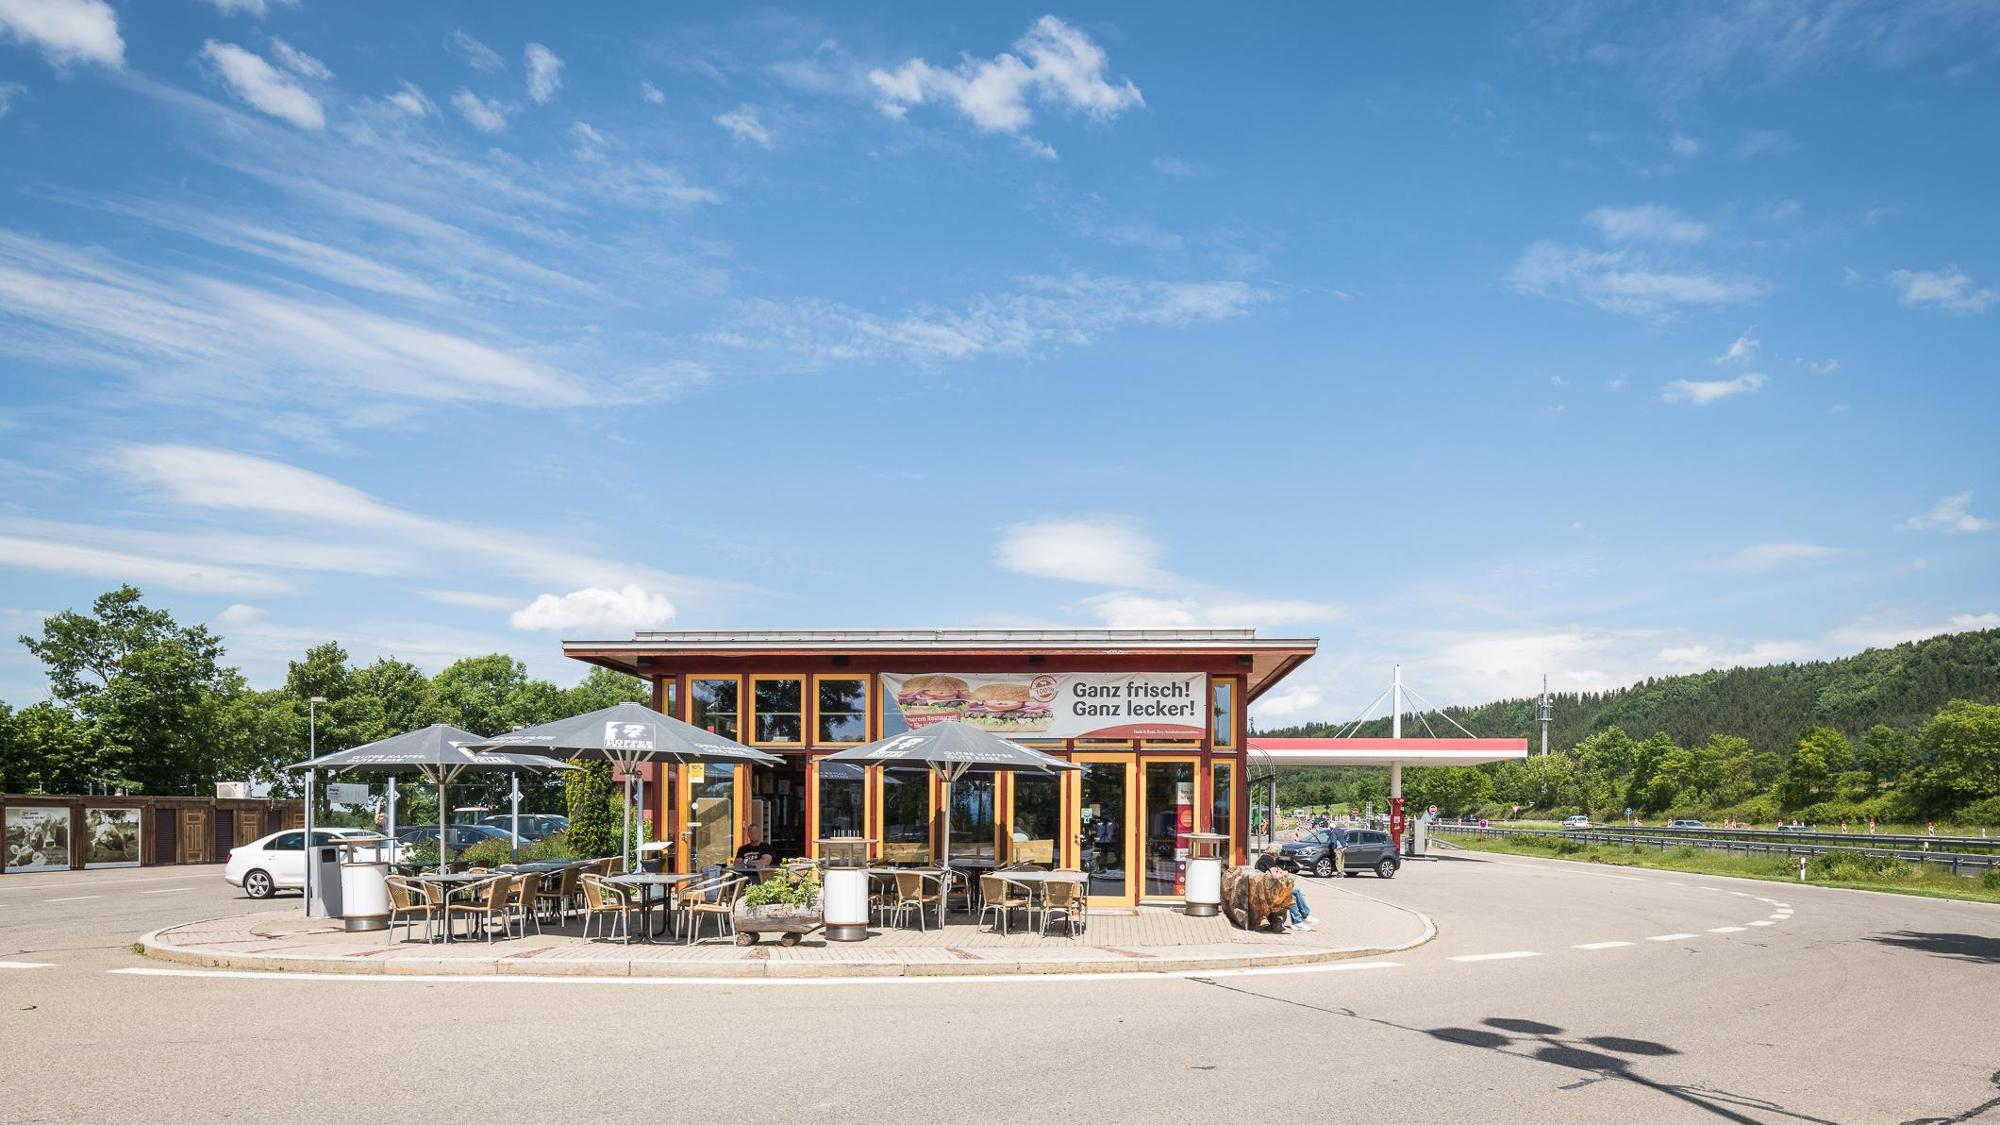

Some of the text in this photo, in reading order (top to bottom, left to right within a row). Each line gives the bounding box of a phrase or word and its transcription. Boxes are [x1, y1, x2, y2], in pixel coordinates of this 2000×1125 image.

[1072, 681, 1190, 698] Ganz frisch!
[1072, 700, 1195, 716] Ganz lecker!
